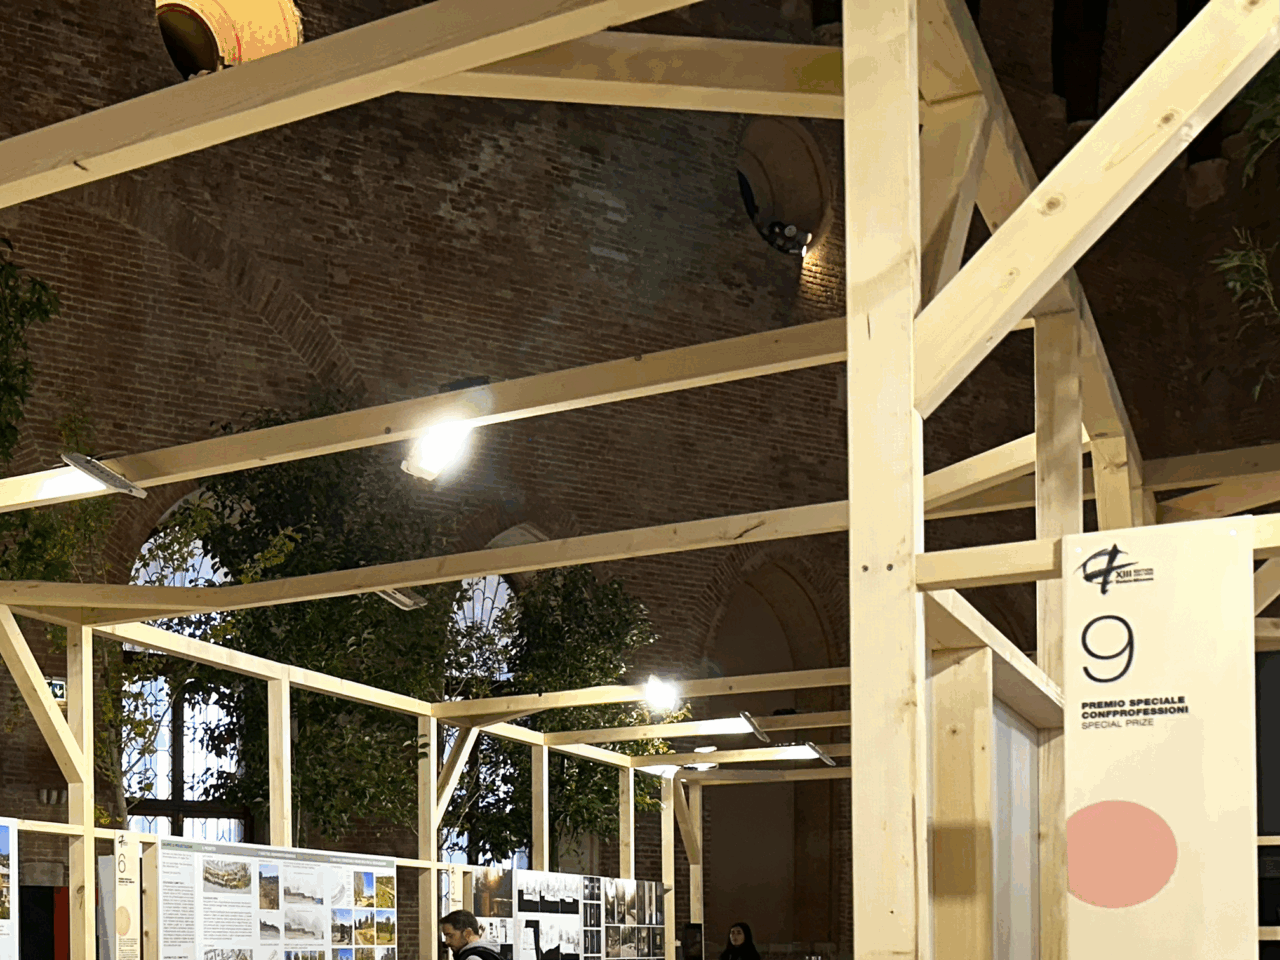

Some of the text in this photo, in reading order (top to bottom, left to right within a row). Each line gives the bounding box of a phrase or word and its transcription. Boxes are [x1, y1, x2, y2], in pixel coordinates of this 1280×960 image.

[1081, 614, 1134, 683] 9
[1081, 696, 1186, 710] PREMIO SPECIALE
[1081, 706, 1189, 719] CONFPROFESSIONI
[1081, 718, 1155, 730] SPECIAL PRIZE
[118, 853, 126, 874] 6
